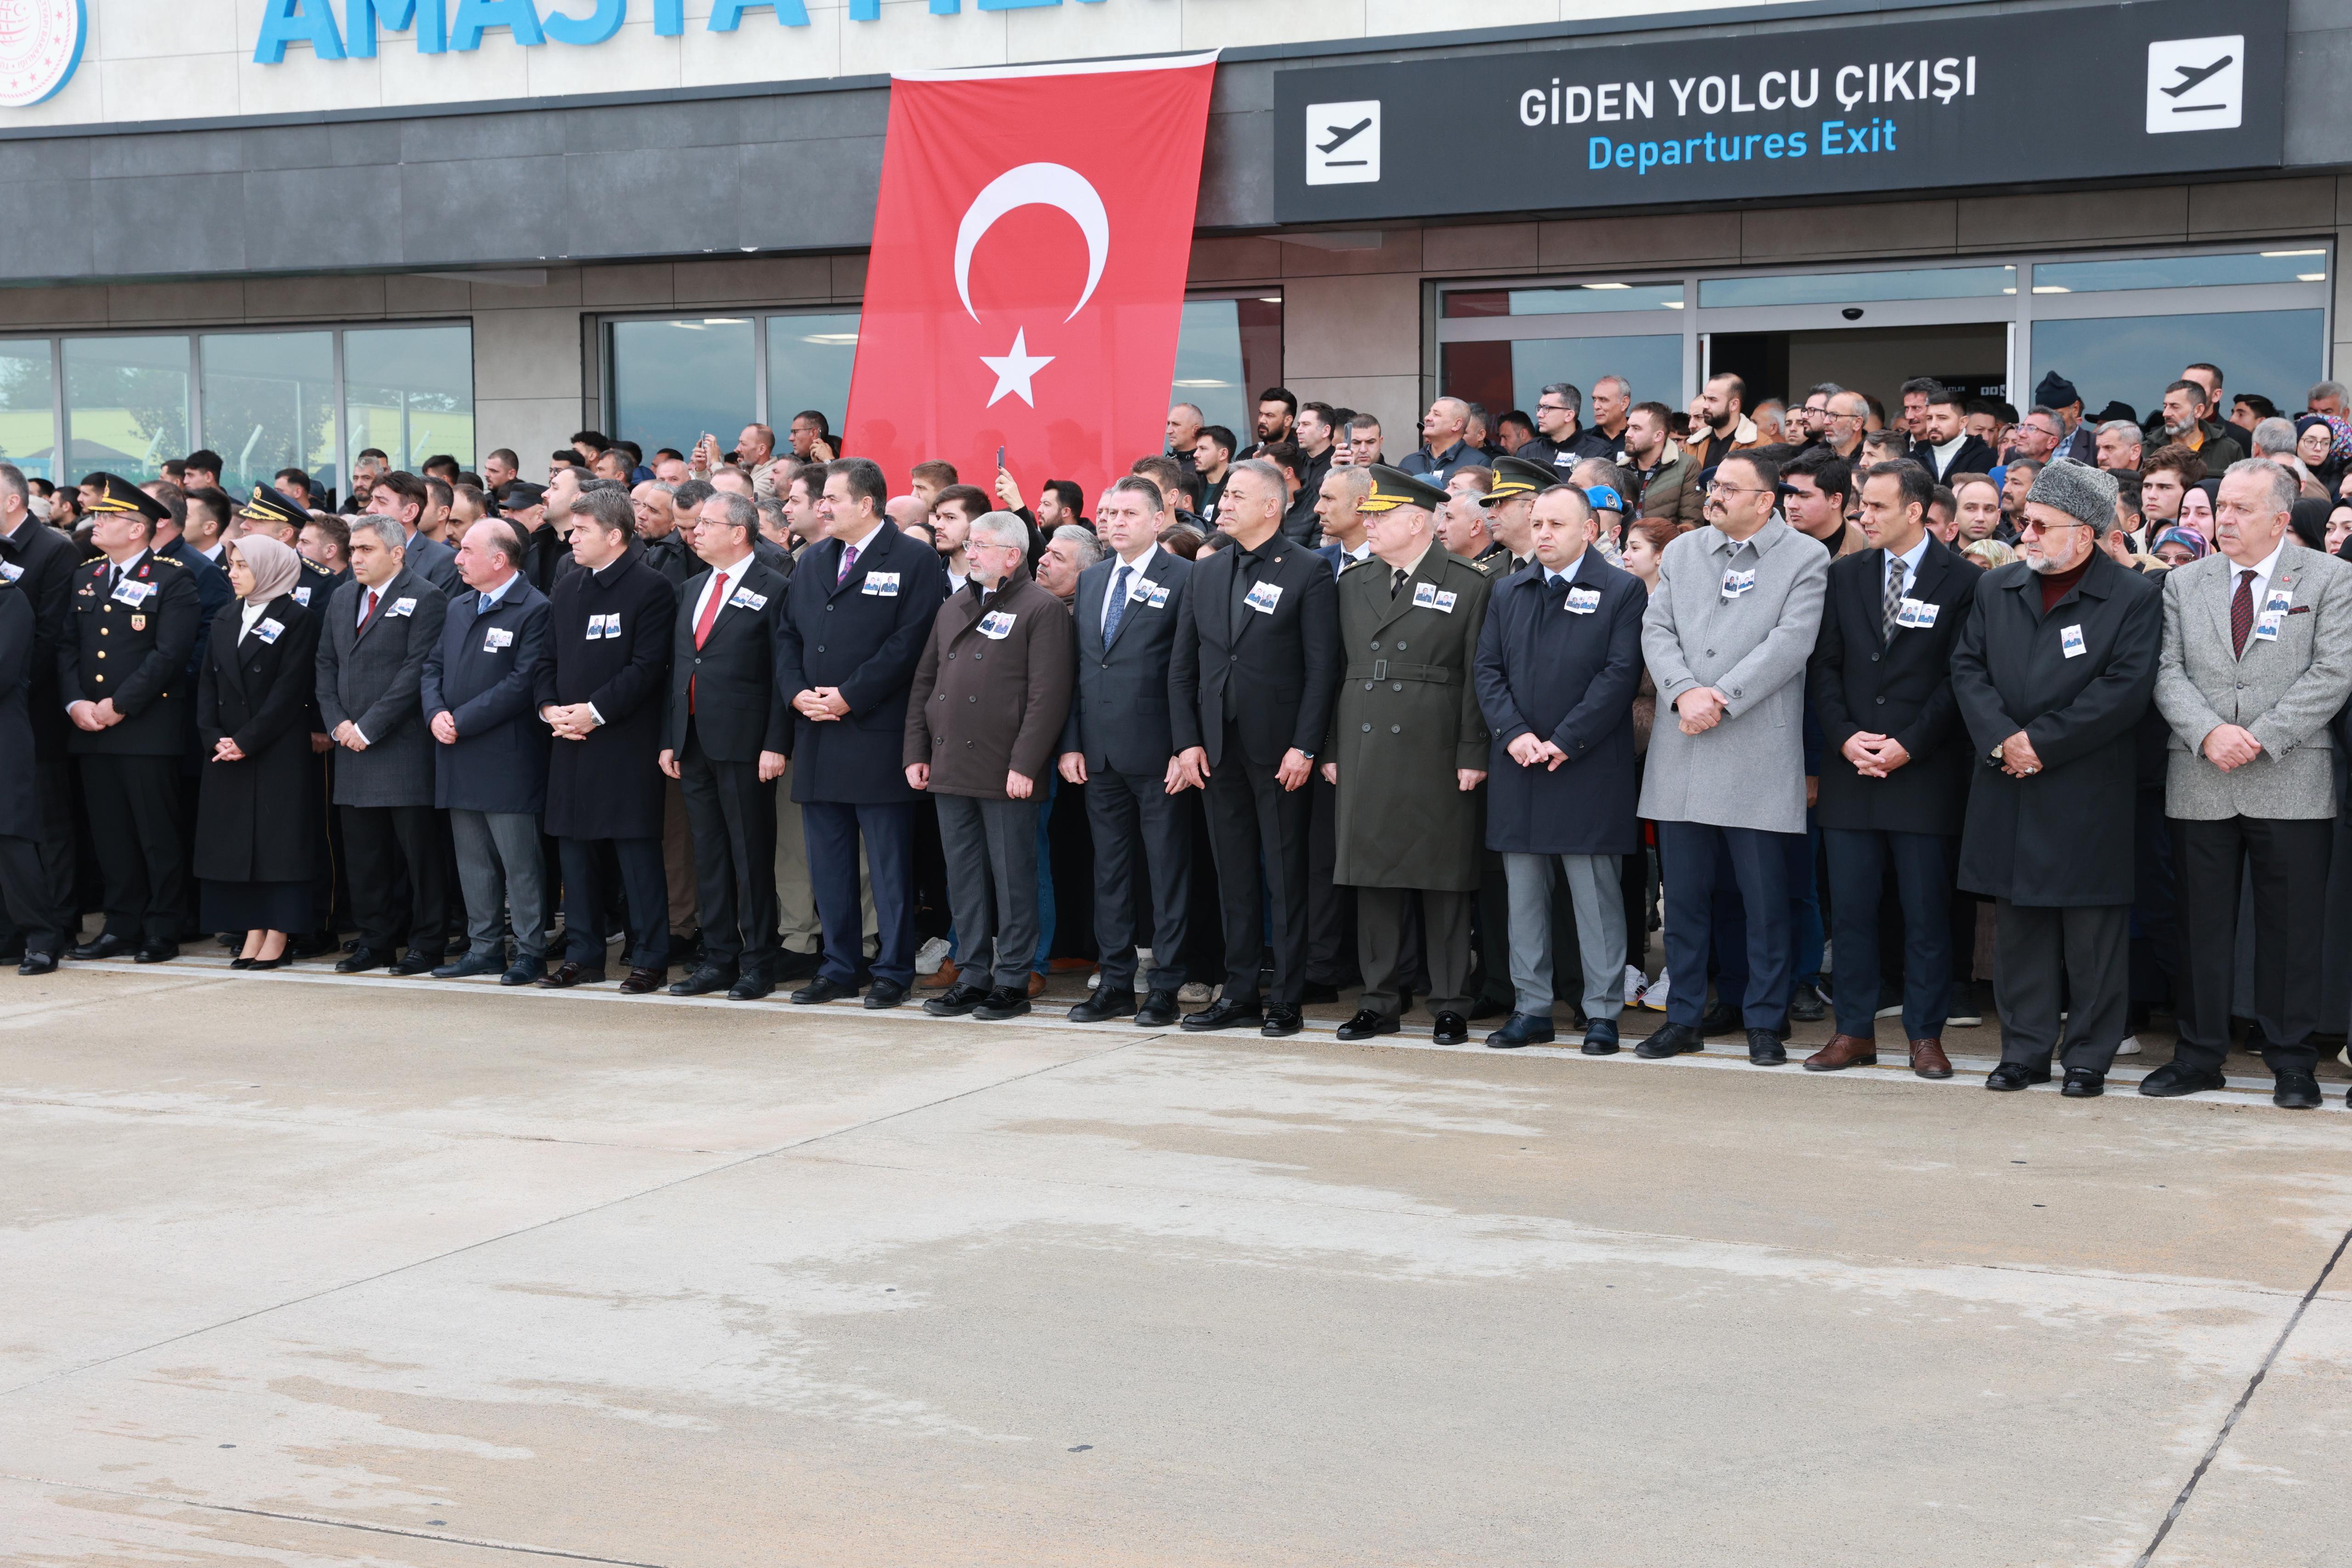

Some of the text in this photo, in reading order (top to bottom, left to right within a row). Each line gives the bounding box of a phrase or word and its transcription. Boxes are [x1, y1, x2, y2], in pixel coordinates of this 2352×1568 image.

[254, 0, 810, 63] AMA
[1520, 56, 1976, 126] GİDEN YOLCU ÇIKIŞI
[1588, 117, 1897, 175] Departures Exit
